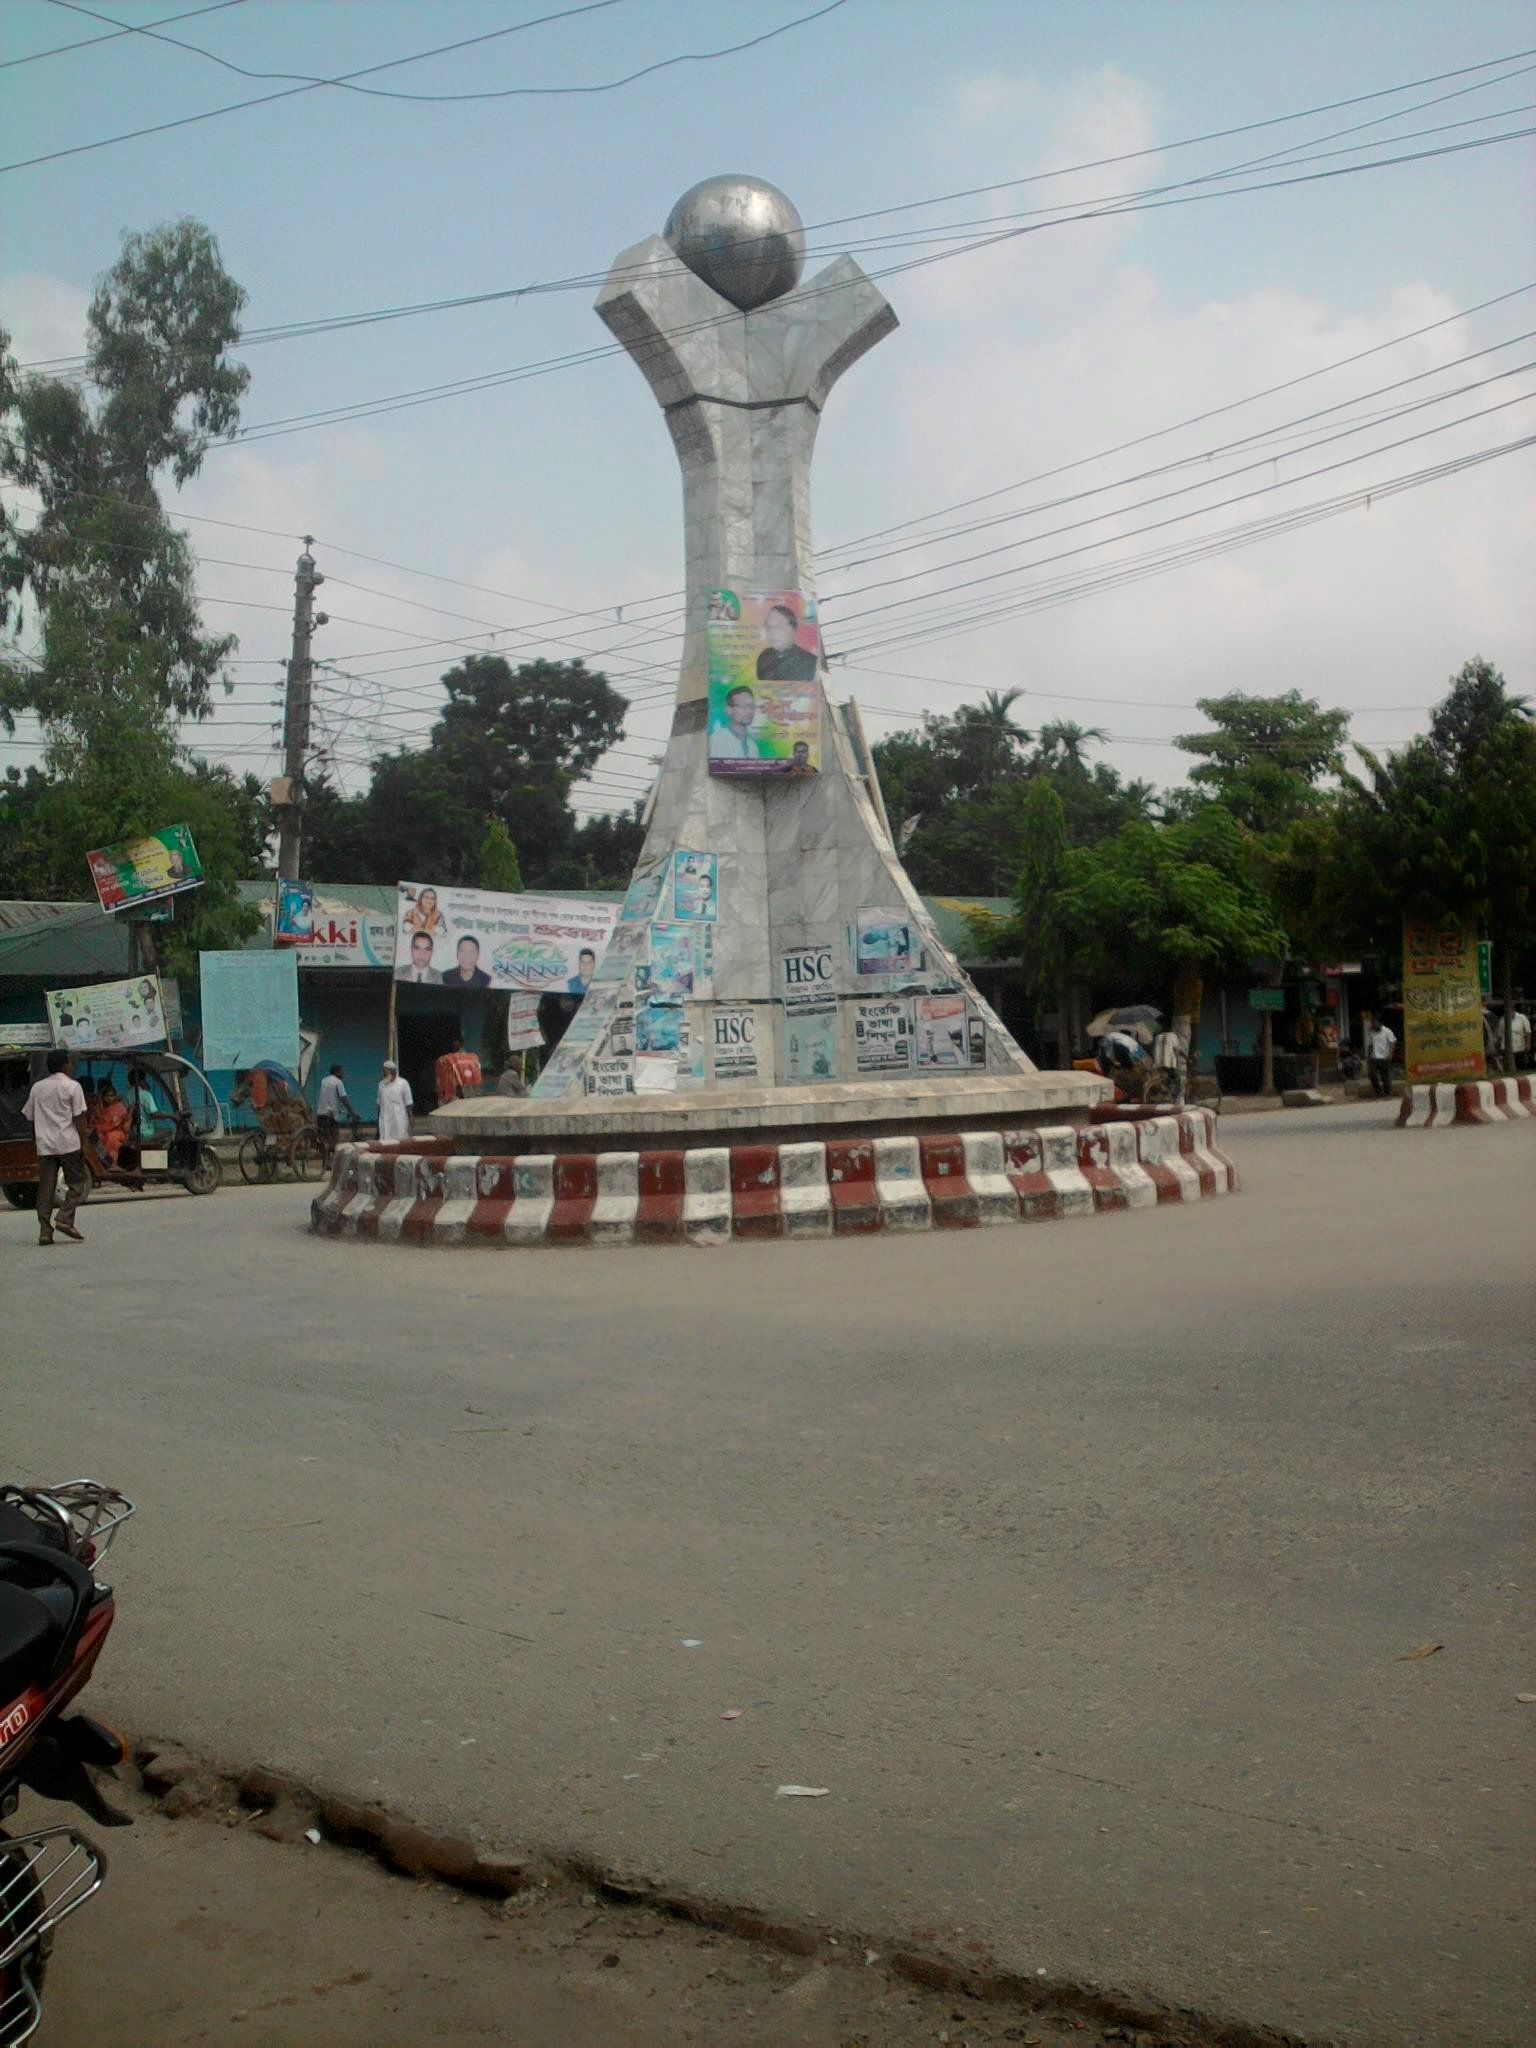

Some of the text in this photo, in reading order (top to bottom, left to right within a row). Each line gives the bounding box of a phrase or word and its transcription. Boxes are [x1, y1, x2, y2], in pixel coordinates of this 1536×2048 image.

[783, 953, 833, 984] HSC
[858, 1002, 901, 1017] ইংরেজি
[714, 1016, 755, 1045] HSC
[866, 1018, 894, 1029] ভাষা
[592, 1058, 629, 1073] ইংরেজি
[598, 1074, 622, 1085] ভাষা
